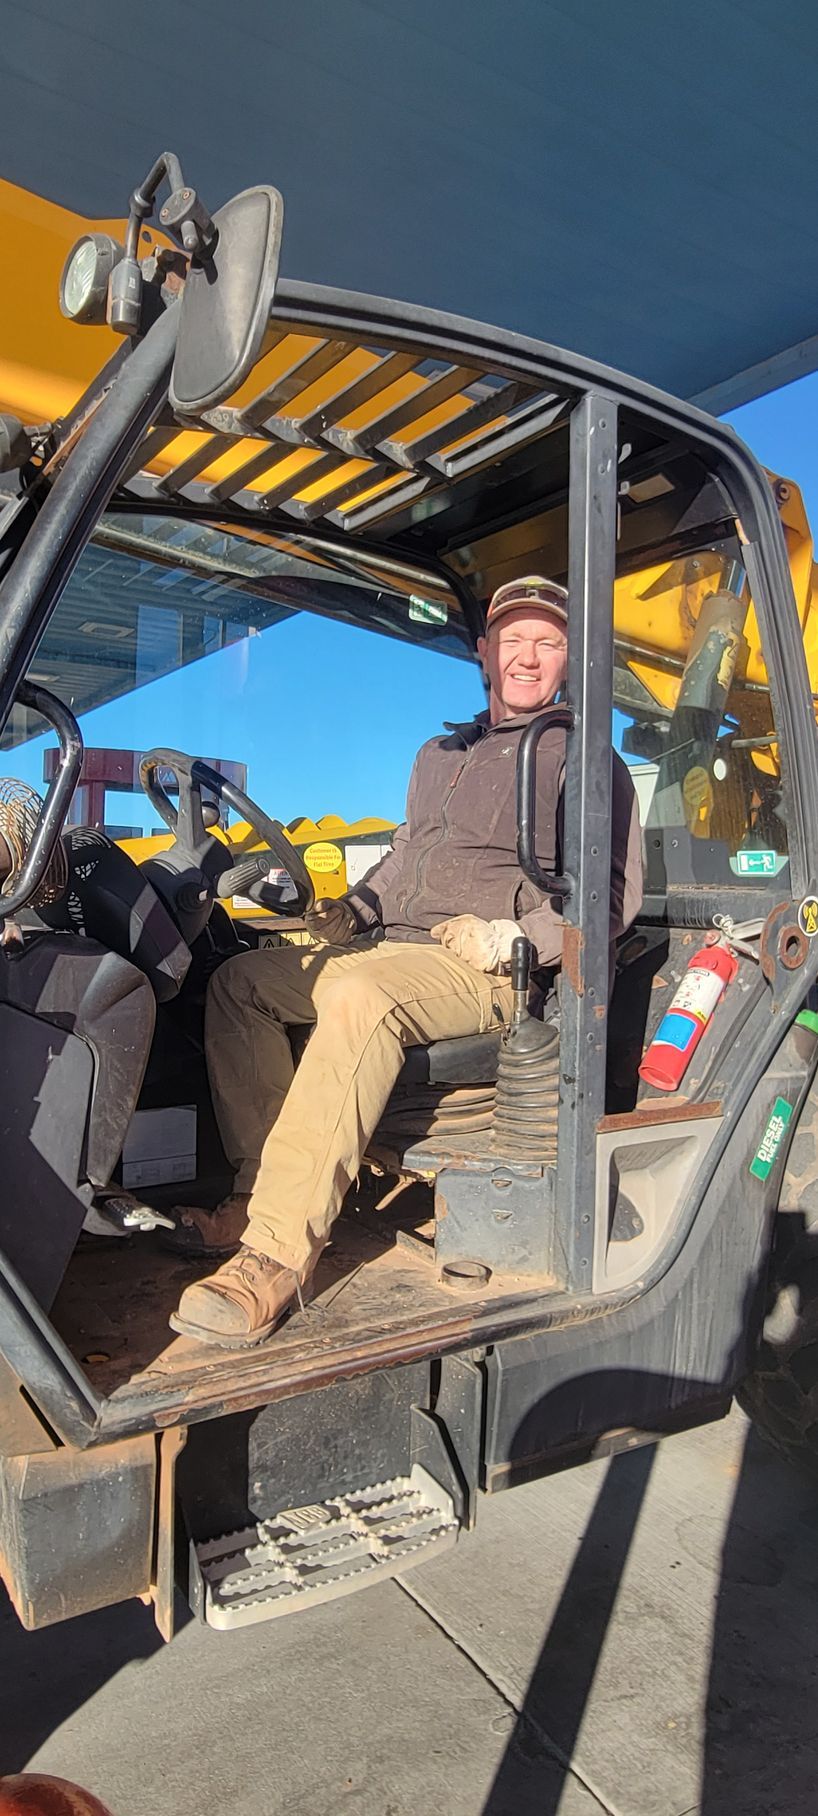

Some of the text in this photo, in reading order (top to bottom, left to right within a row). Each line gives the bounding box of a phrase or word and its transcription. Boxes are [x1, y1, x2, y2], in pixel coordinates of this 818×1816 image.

[757, 1115, 783, 1162] DIESEL
[765, 1120, 785, 1163] FUEL ONLY
